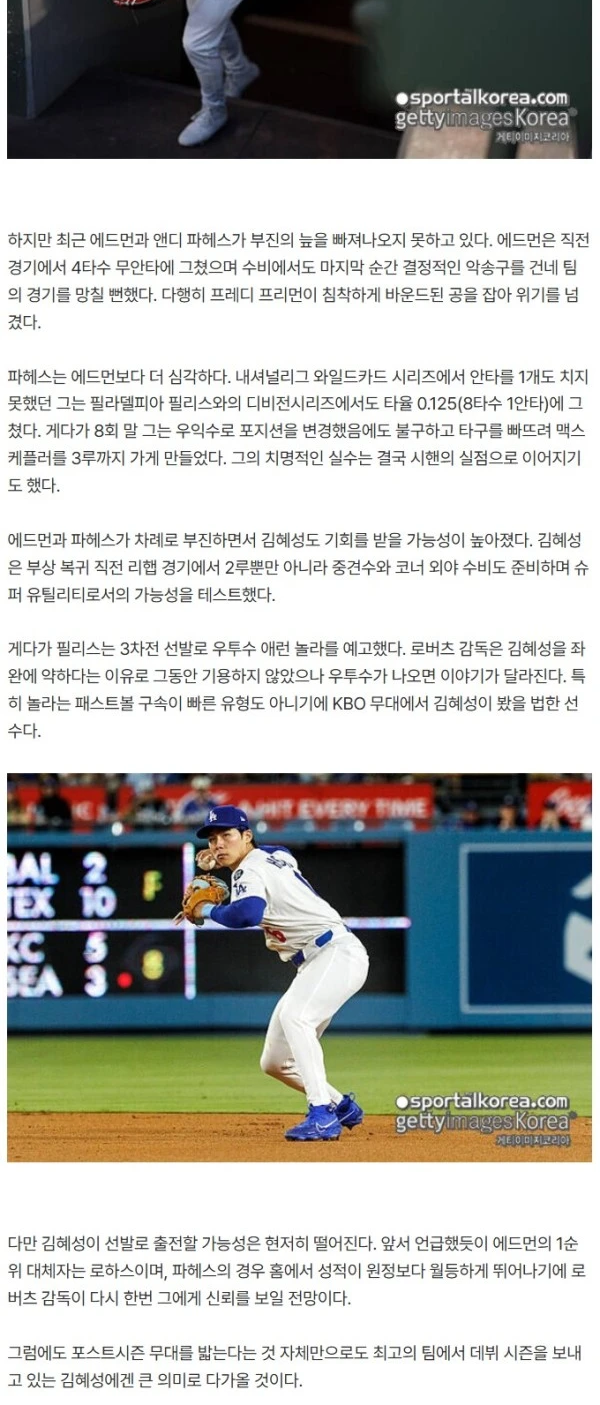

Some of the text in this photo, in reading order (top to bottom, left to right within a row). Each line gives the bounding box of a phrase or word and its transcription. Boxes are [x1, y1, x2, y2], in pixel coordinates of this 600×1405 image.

[82, 851, 108, 884] 2
[79, 886, 117, 918] 10
[84, 965, 108, 997] 3
